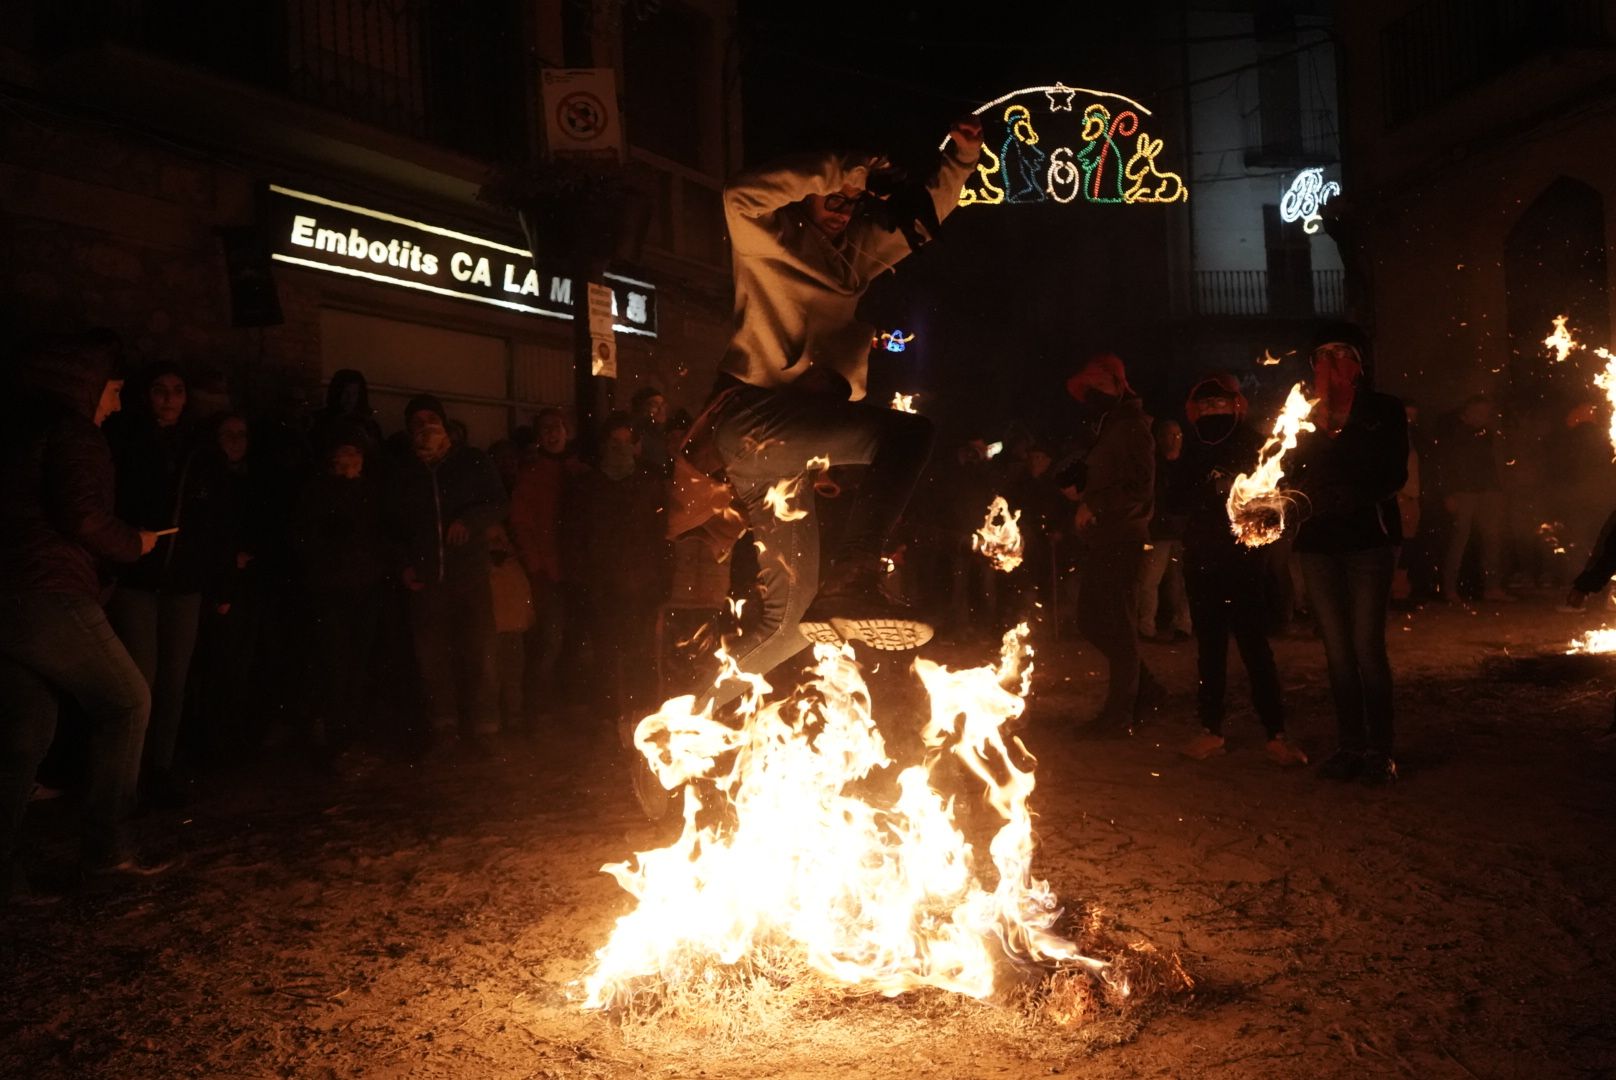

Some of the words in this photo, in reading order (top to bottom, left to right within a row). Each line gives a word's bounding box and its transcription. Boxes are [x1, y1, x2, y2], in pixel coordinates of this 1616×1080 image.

[291, 215, 439, 275] Embotits
[450, 252, 492, 287] CA
[503, 264, 539, 297] LA
